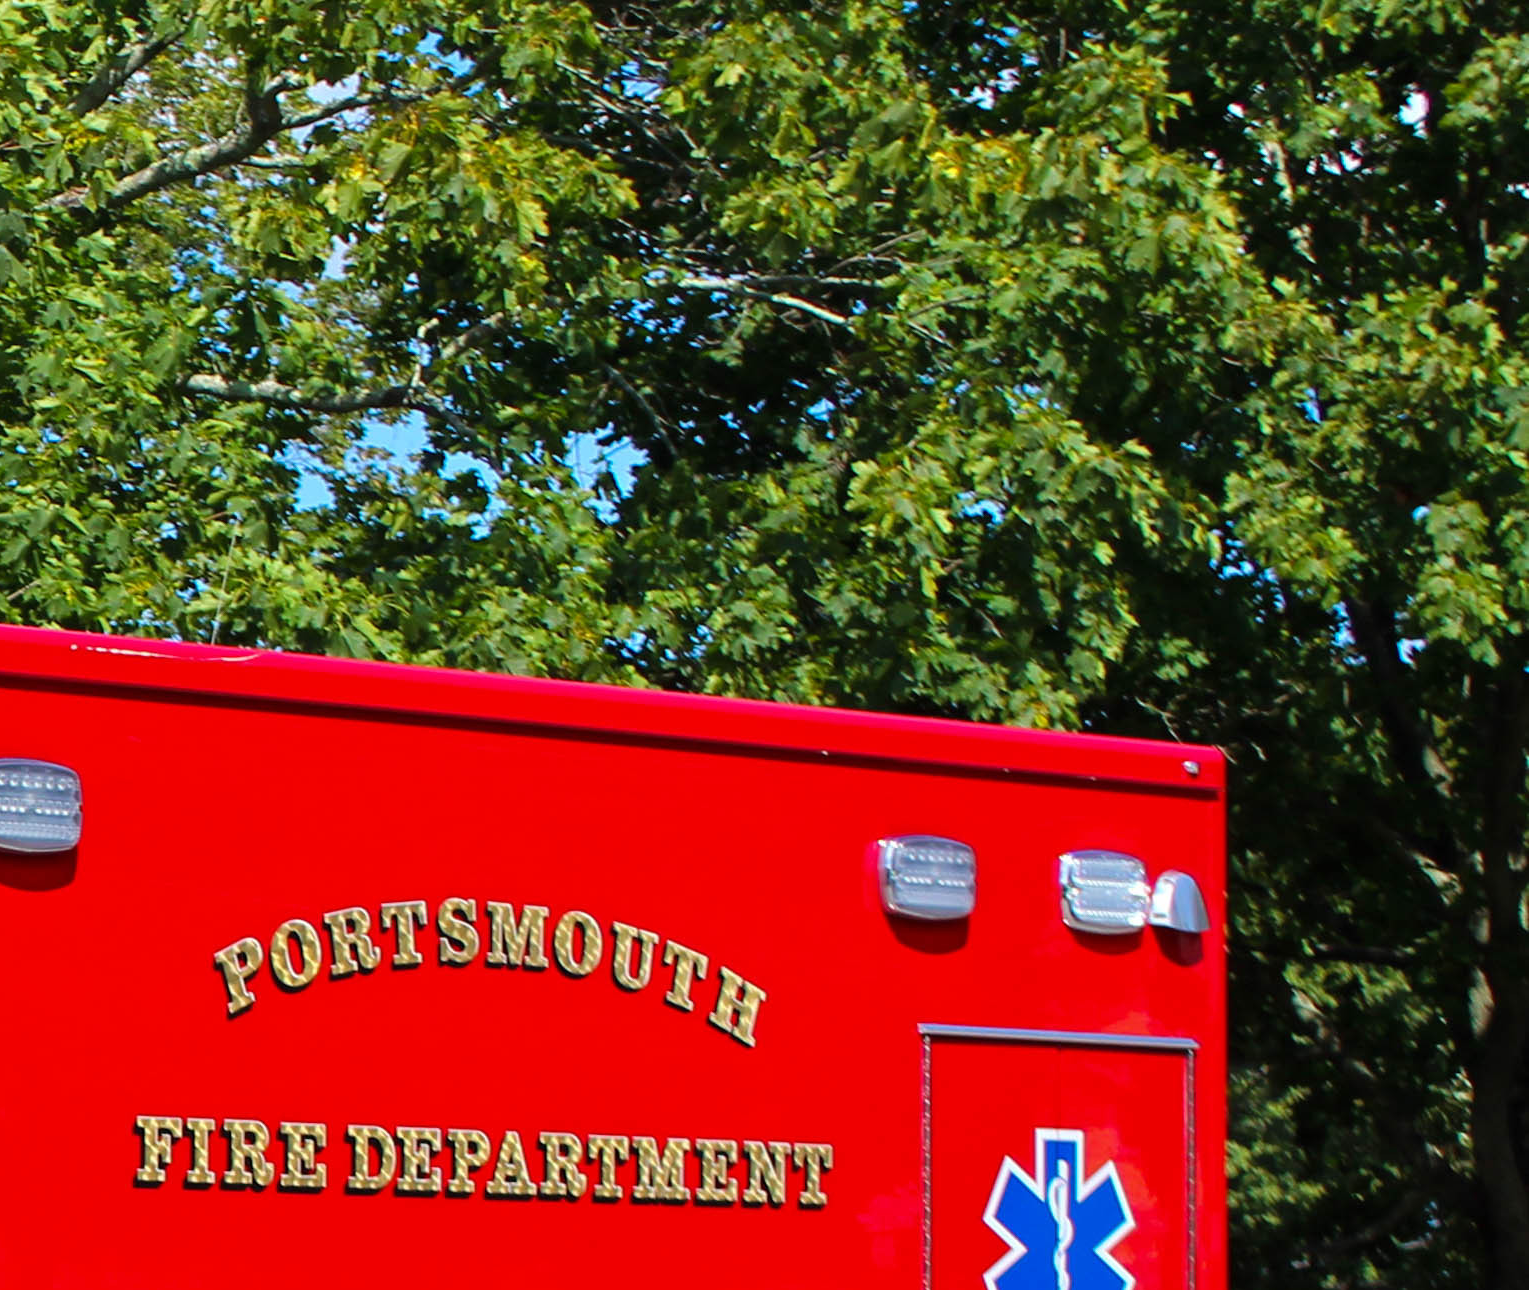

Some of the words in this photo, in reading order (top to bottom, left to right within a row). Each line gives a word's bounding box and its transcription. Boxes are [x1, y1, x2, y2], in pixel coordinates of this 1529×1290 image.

[212, 896, 769, 1049] PORTSMOUTH
[134, 1115, 329, 1190] FIRE
[345, 1123, 835, 1207] DEPARTMENT
